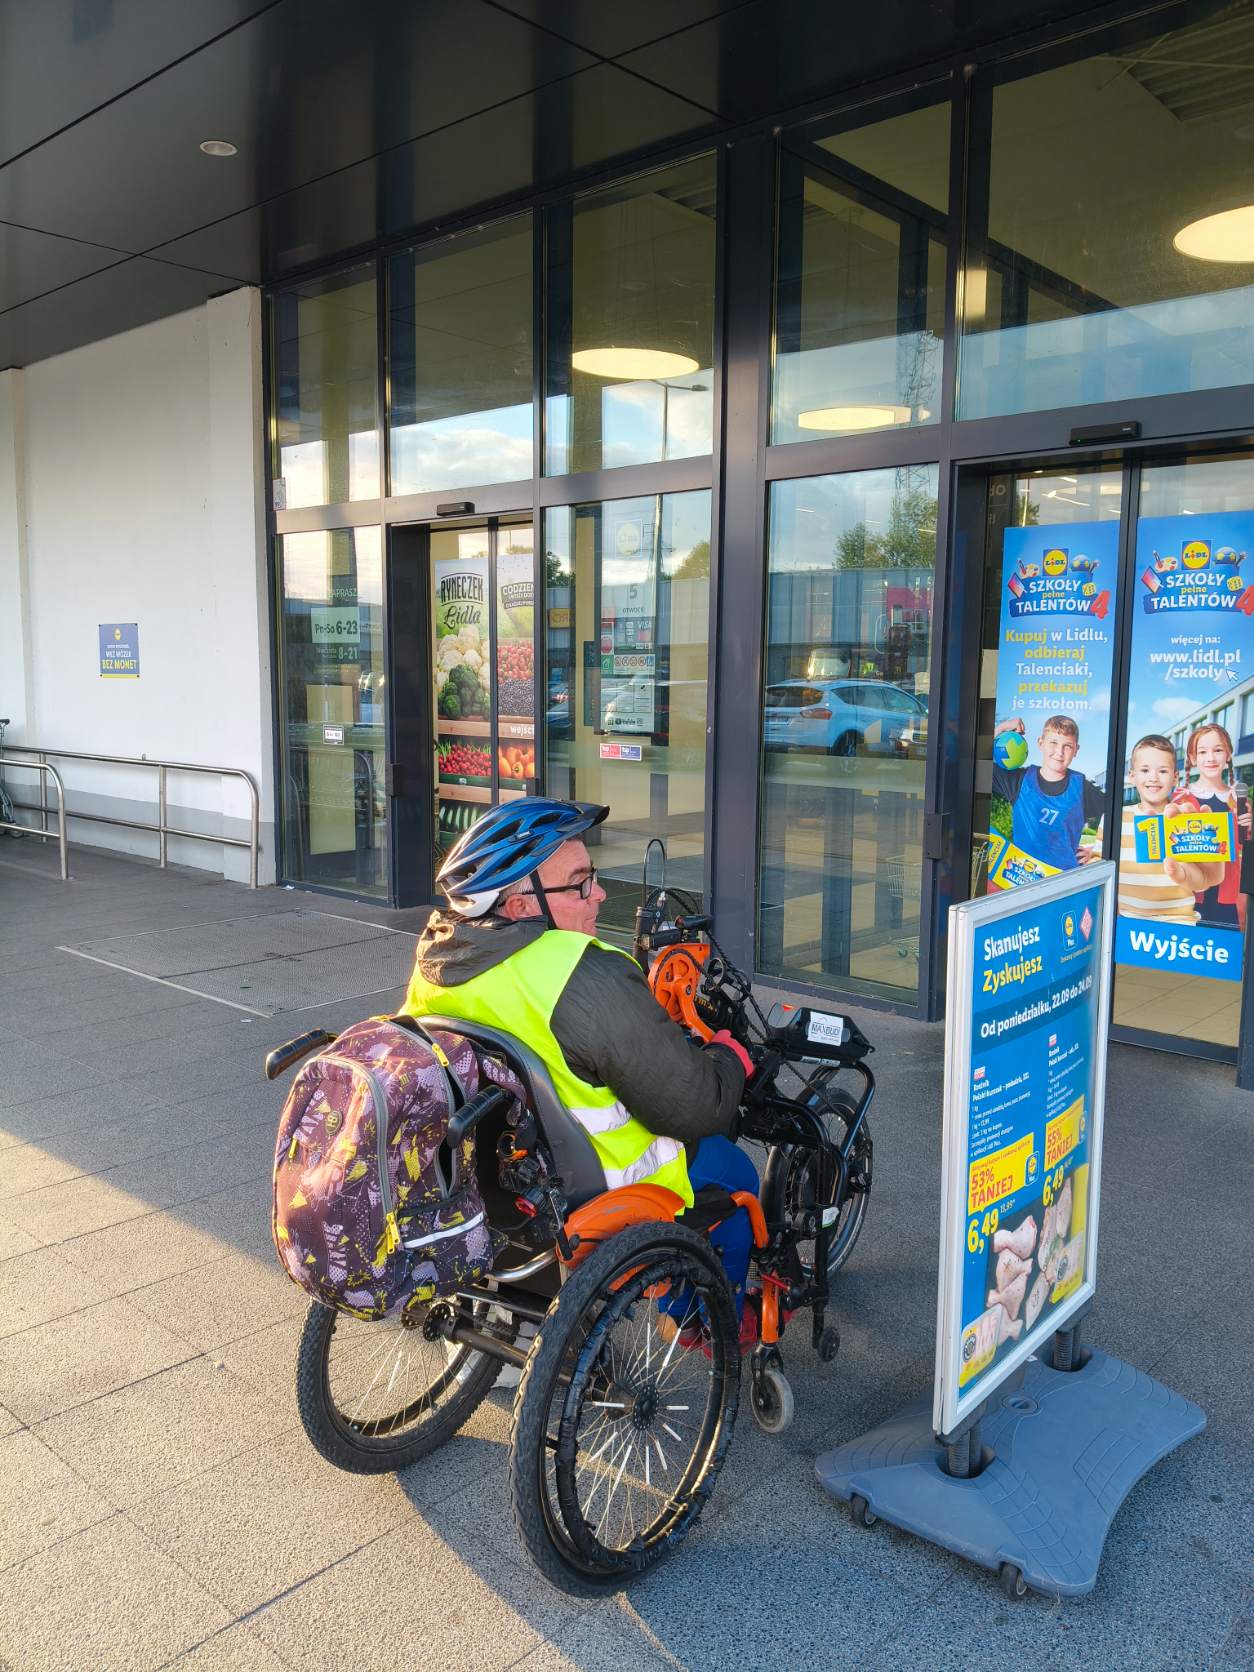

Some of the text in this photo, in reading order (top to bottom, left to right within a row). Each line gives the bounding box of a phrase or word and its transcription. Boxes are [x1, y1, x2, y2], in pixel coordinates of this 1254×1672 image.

[440, 576, 484, 604] RYNECZEK
[1029, 579, 1081, 594] SZKOŁY
[1166, 572, 1226, 588] SZKOŁY
[1016, 590, 1111, 620] TALENTÓW 4
[1151, 585, 1254, 617] TALENTÓW 4
[336, 620, 358, 635] 6-23
[444, 605, 482, 630] Lidla
[1006, 628, 1108, 644] Kupuj w Lidlu,
[1171, 635, 1221, 646] więcej na:
[338, 647, 358, 659] 8-21
[1024, 646, 1085, 662] odbieraj
[1150, 649, 1241, 666] www.lidl.pl
[1016, 662, 1093, 678] Talenciaki,
[1164, 664, 1224, 681] /szkoly
[1018, 680, 1088, 697] przekazuj
[1012, 696, 1092, 711] je szkołom.
[1040, 808, 1059, 826] 27
[1136, 818, 1160, 860] 1
[984, 926, 1040, 960] Skanujesz
[1130, 930, 1230, 964] Wyjście
[982, 956, 1043, 995] Zyskujesz
[980, 1019, 996, 1038] Od
[998, 1001, 1052, 1036] poniedziałku,
[1052, 988, 1070, 1008] 22.09
[1070, 985, 1078, 999] do
[972, 1166, 994, 1192] 53%
[1042, 1164, 1064, 1208] 6,49
[971, 1175, 1014, 1208] TANIEJ
[967, 1208, 999, 1255] 6,49
